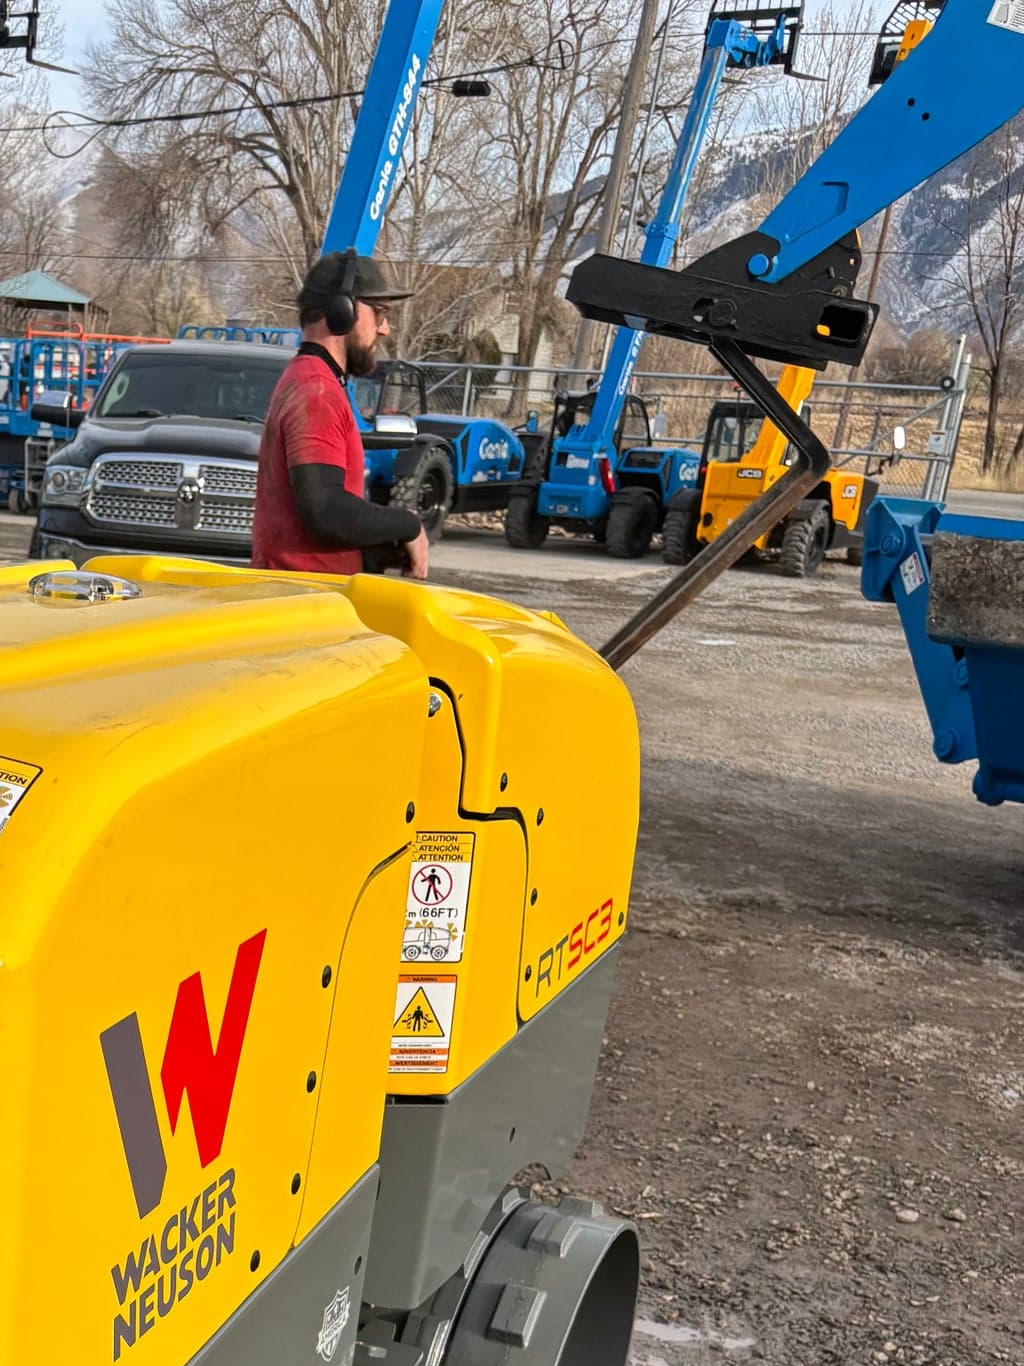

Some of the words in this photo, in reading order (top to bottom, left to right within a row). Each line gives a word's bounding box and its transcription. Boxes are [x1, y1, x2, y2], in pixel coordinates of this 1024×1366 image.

[370, 160, 393, 221] Genie
[388, 52, 422, 157] GTH-844
[479, 437, 509, 460] Genie
[737, 468, 763, 479] JCB
[419, 843, 460, 852] ATENCIÓN
[421, 834, 458, 843] CAUTION
[418, 853, 464, 861] ATTENTION
[535, 897, 613, 999] RTSC3
[110, 1168, 237, 1306] WACKER
[113, 1211, 236, 1363] NEUSON
